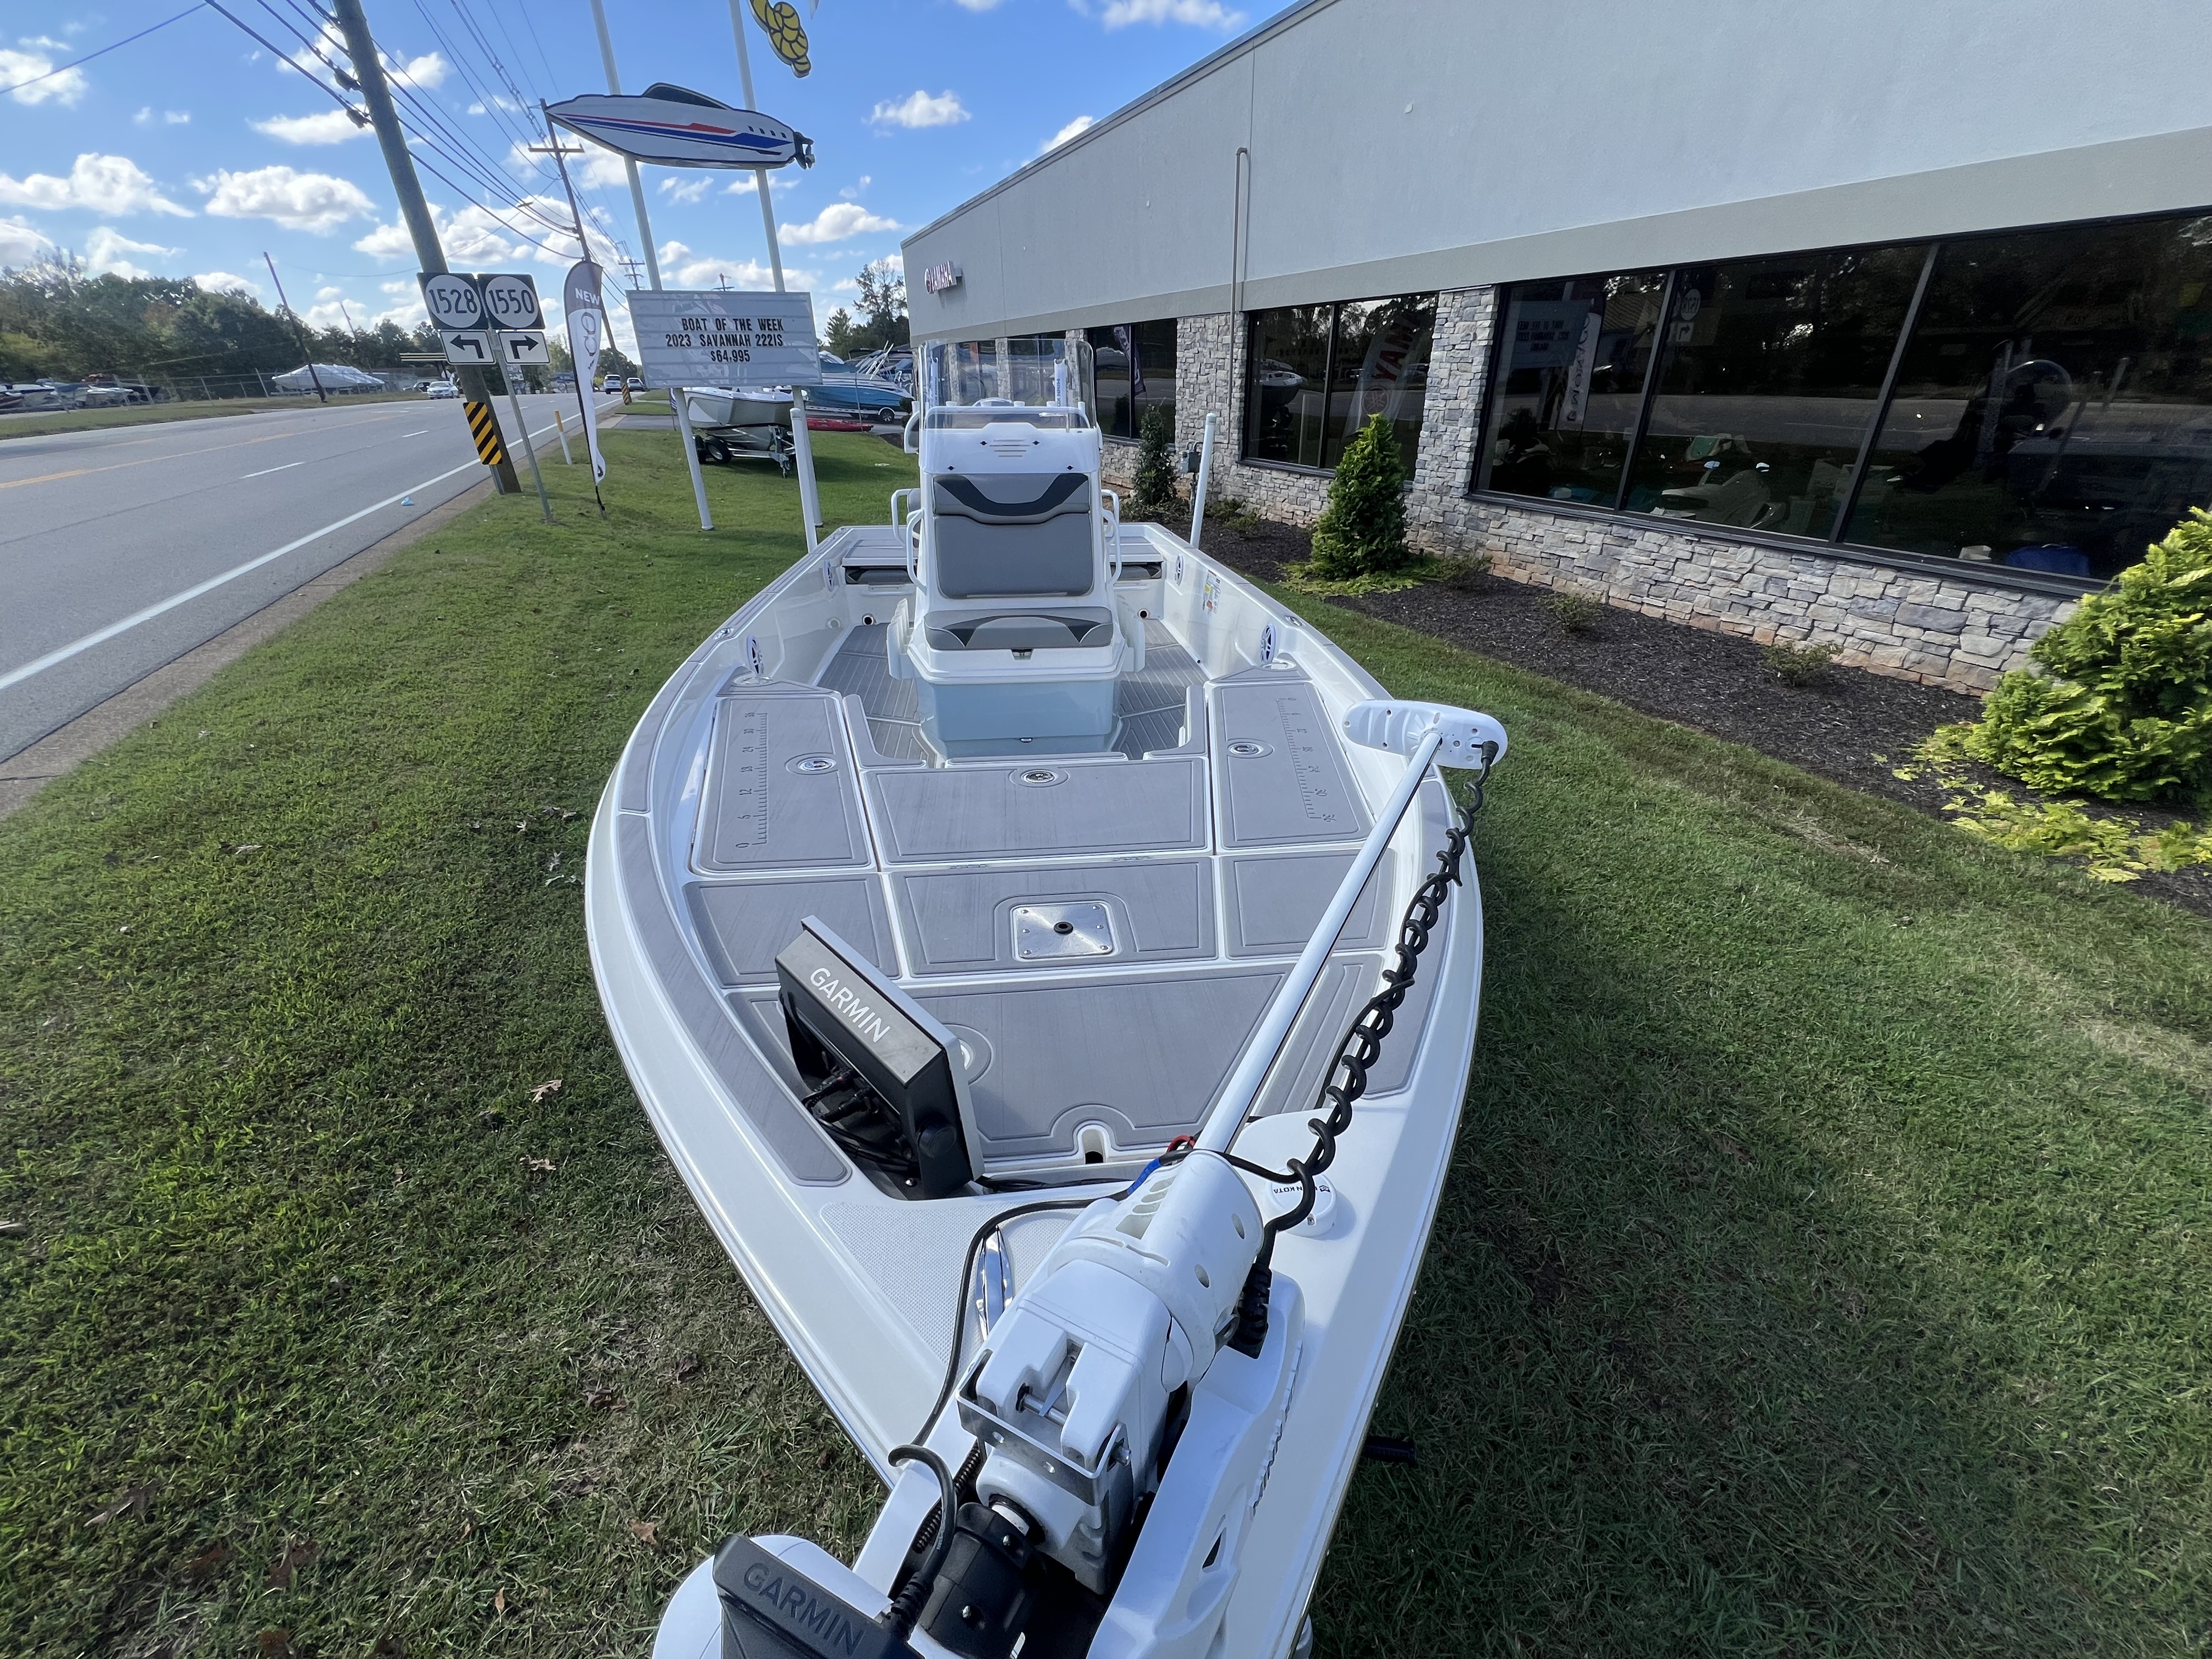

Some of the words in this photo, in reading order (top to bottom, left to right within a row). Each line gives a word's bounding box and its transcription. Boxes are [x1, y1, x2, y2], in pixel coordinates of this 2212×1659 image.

[429, 289, 478, 314] 1528
[488, 289, 535, 314] 1550
[575, 287, 600, 305] NEW
[681, 318, 707, 331] BOAT
[715, 318, 727, 331] OF
[733, 318, 752, 331] THE
[758, 318, 784, 331] WEEK
[665, 334, 691, 347] 2023
[700, 334, 751, 347] SAVANNAH
[710, 349, 751, 363] $64,995
[810, 967, 891, 1043] GARMIN
[743, 1562, 866, 1656] GARMIN
